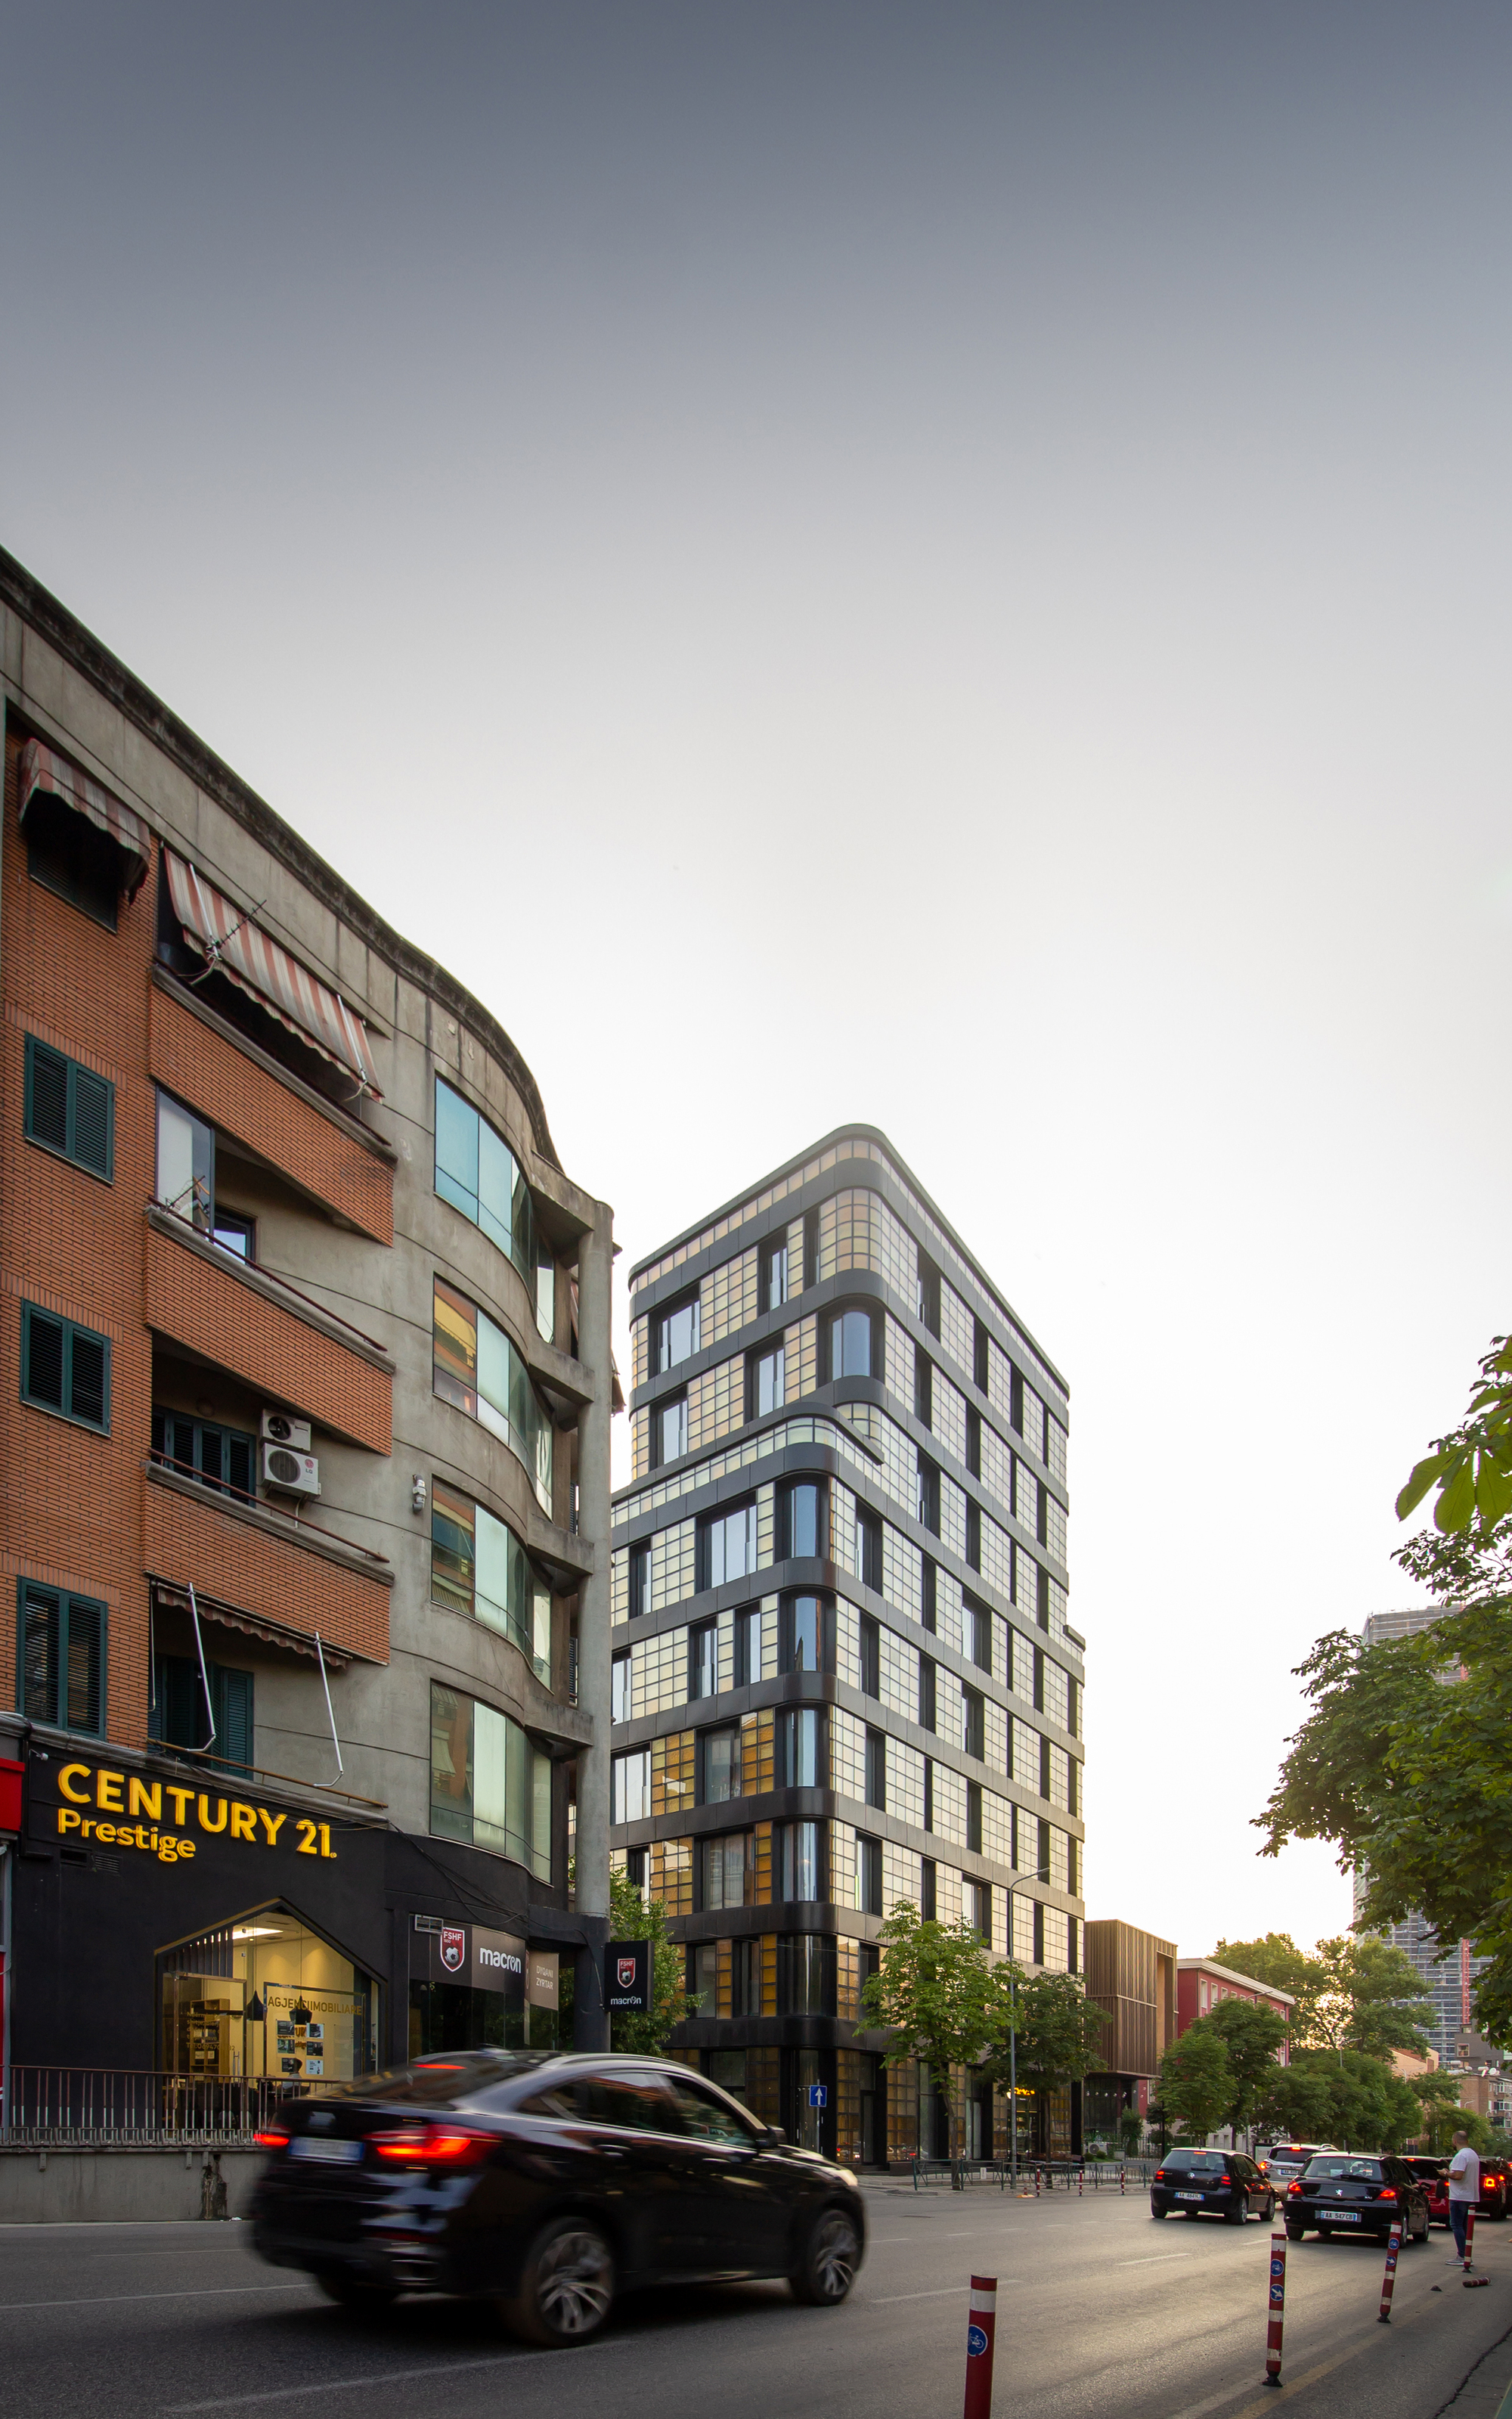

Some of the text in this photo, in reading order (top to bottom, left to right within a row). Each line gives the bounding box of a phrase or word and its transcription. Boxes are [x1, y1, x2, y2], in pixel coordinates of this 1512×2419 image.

[58, 1763, 288, 1846] CENTURY
[58, 1808, 196, 1862] Prestige
[444, 1931, 462, 1941] FSHF
[479, 1947, 522, 1974] macron
[536, 1977, 553, 1990] ZYRTAR
[610, 1996, 643, 2005] macron
